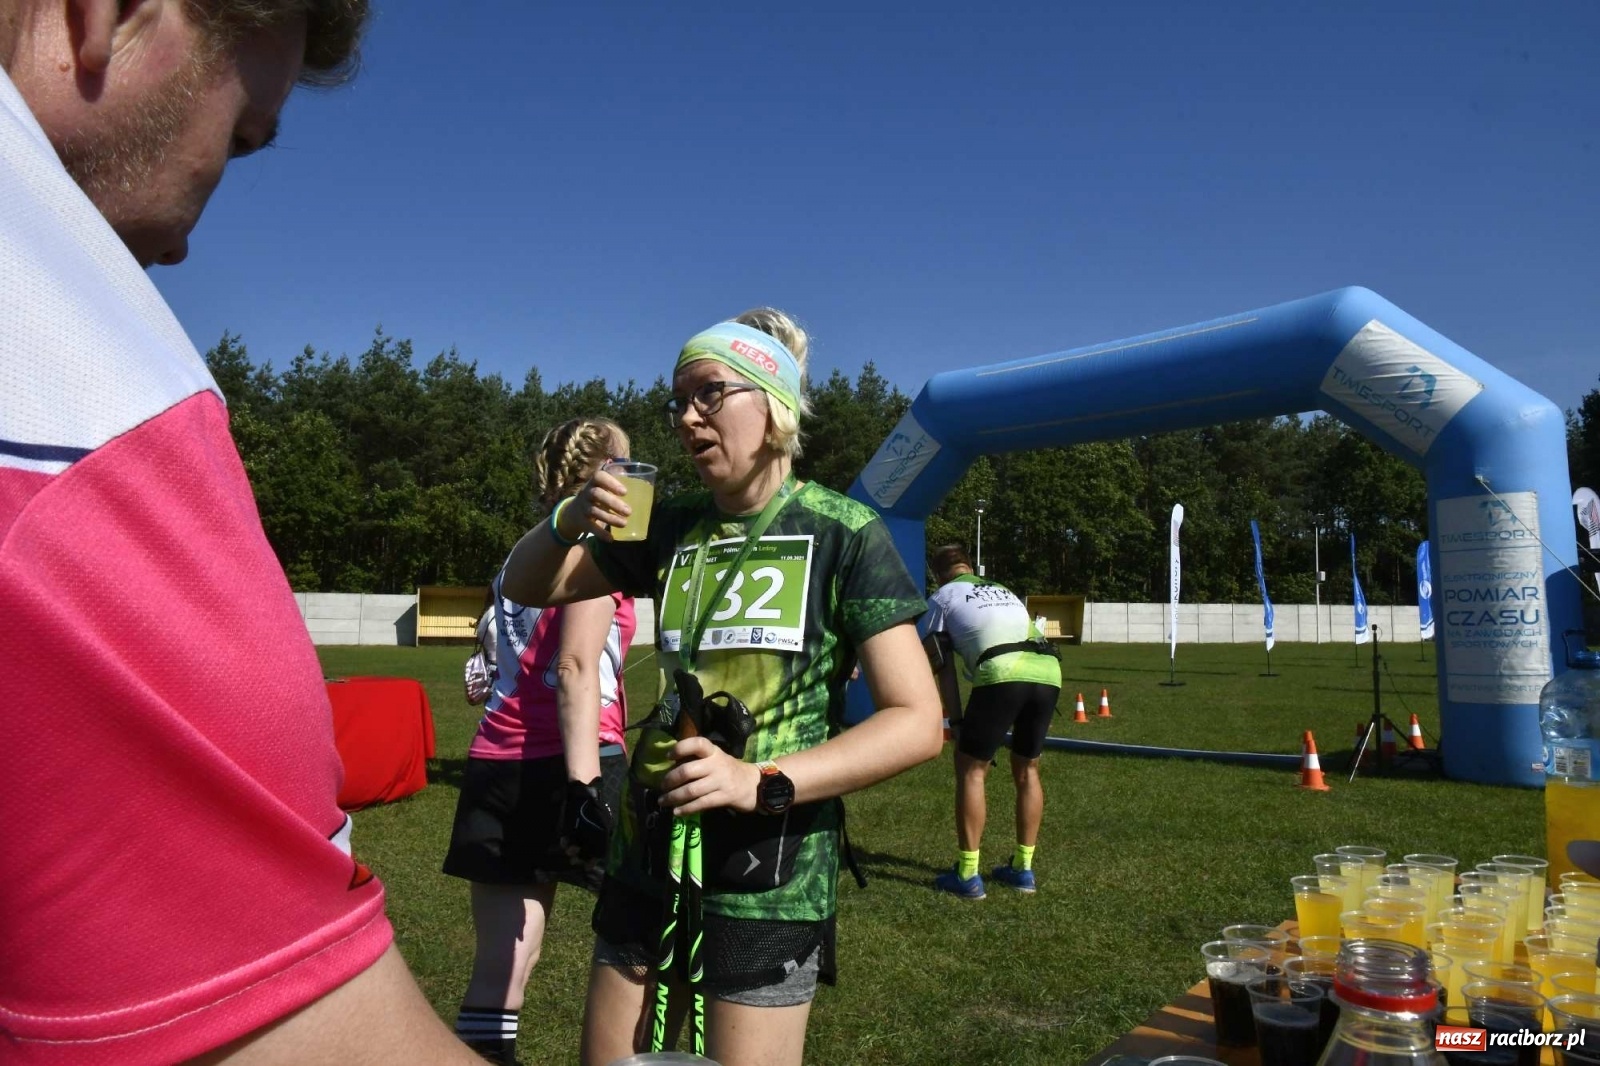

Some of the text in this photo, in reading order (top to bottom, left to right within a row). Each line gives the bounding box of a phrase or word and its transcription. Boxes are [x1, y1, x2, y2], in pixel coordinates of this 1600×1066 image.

[736, 343, 776, 373] HERO
[1332, 366, 1435, 438] TIMESPORT
[874, 434, 928, 499] TIMESPORT
[1440, 529, 1535, 544] TIMESPORT
[1443, 571, 1538, 583] ELEKTRONICZNY
[682, 566, 785, 621] 32
[1444, 586, 1540, 603] POMIAR
[1446, 609, 1540, 626] CZASU
[1465, 628, 1542, 638] ZAWODACH
[1450, 640, 1538, 649] SPORTOWYCH
